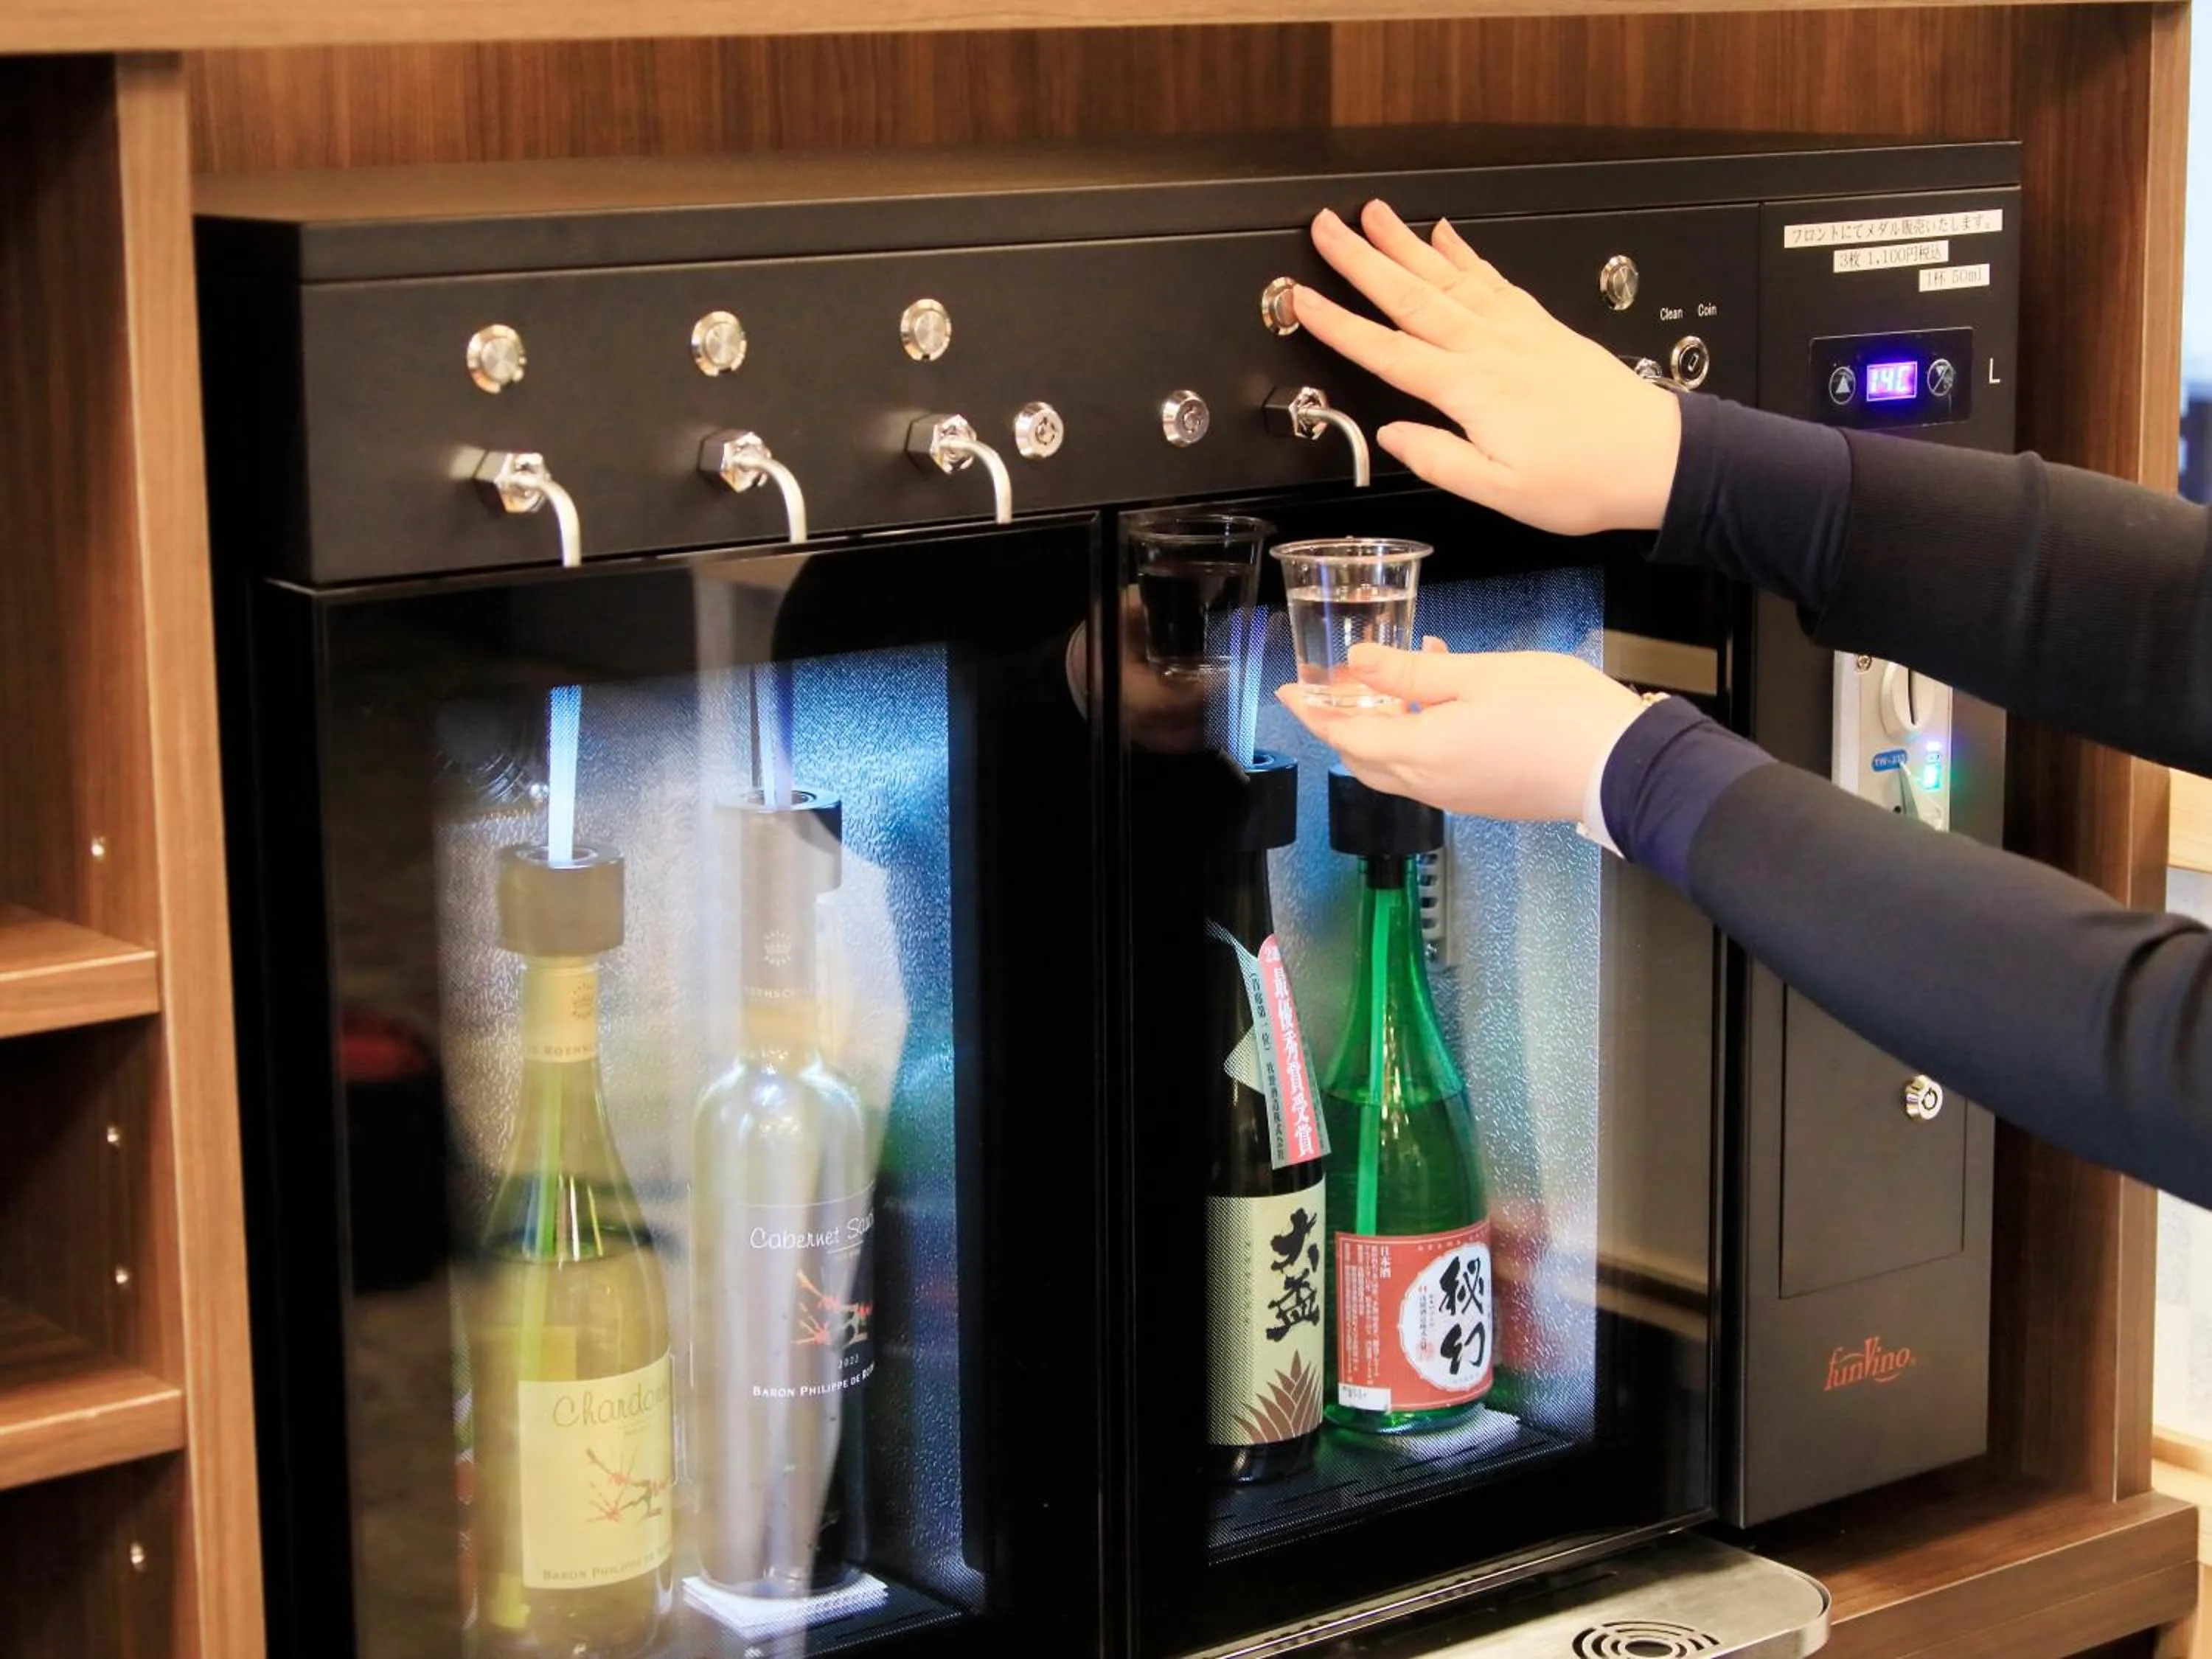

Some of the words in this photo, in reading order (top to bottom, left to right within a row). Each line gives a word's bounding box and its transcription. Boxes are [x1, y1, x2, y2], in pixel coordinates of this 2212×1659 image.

[1792, 215, 1992, 244] フロントにてメダル販売いたします。
[1839, 251, 1860, 268] 3枚
[1926, 270, 1946, 287] 1杯
[1951, 267, 1983, 284] 50ml
[1660, 307, 1683, 321] Clean
[1698, 303, 1717, 317] Coin
[1989, 358, 2001, 384] L
[1273, 967, 1314, 1158] 最優秀賞受賞
[749, 1226, 841, 1250] Cabernet
[1439, 1256, 1486, 1375] 秘幻
